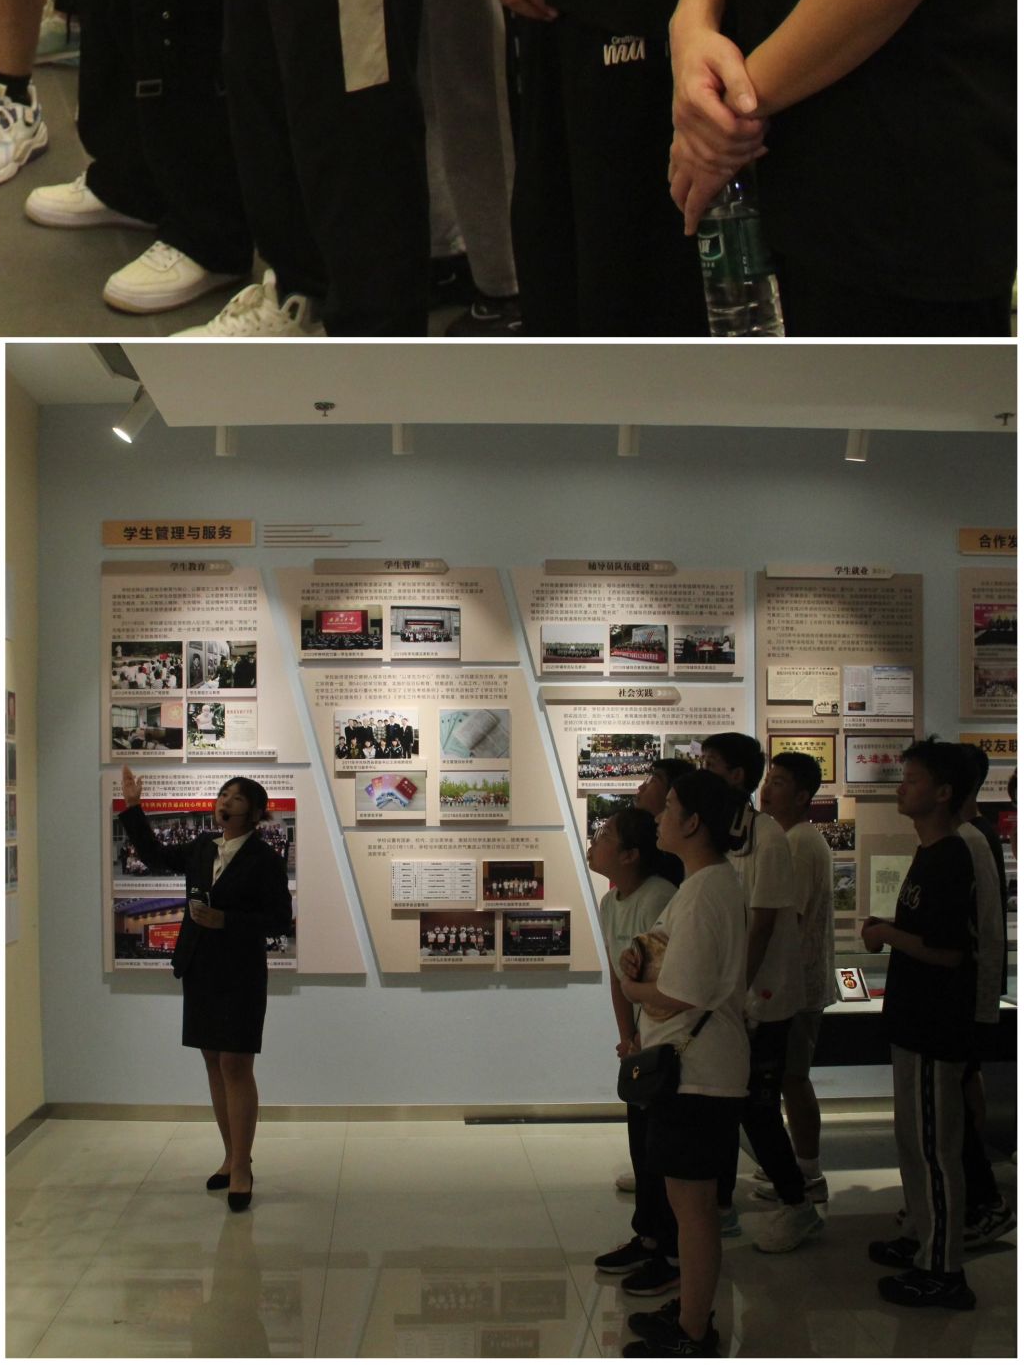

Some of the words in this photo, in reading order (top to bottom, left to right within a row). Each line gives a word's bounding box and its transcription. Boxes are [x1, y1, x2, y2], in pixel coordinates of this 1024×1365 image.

[123, 525, 233, 541] 学生管理与服务
[170, 562, 206, 572] 学生教育
[384, 560, 421, 570] 学生管理
[588, 562, 650, 572] 辅导员队伍建设
[618, 688, 654, 698] 社会实践
[980, 739, 1017, 753] 校友联
